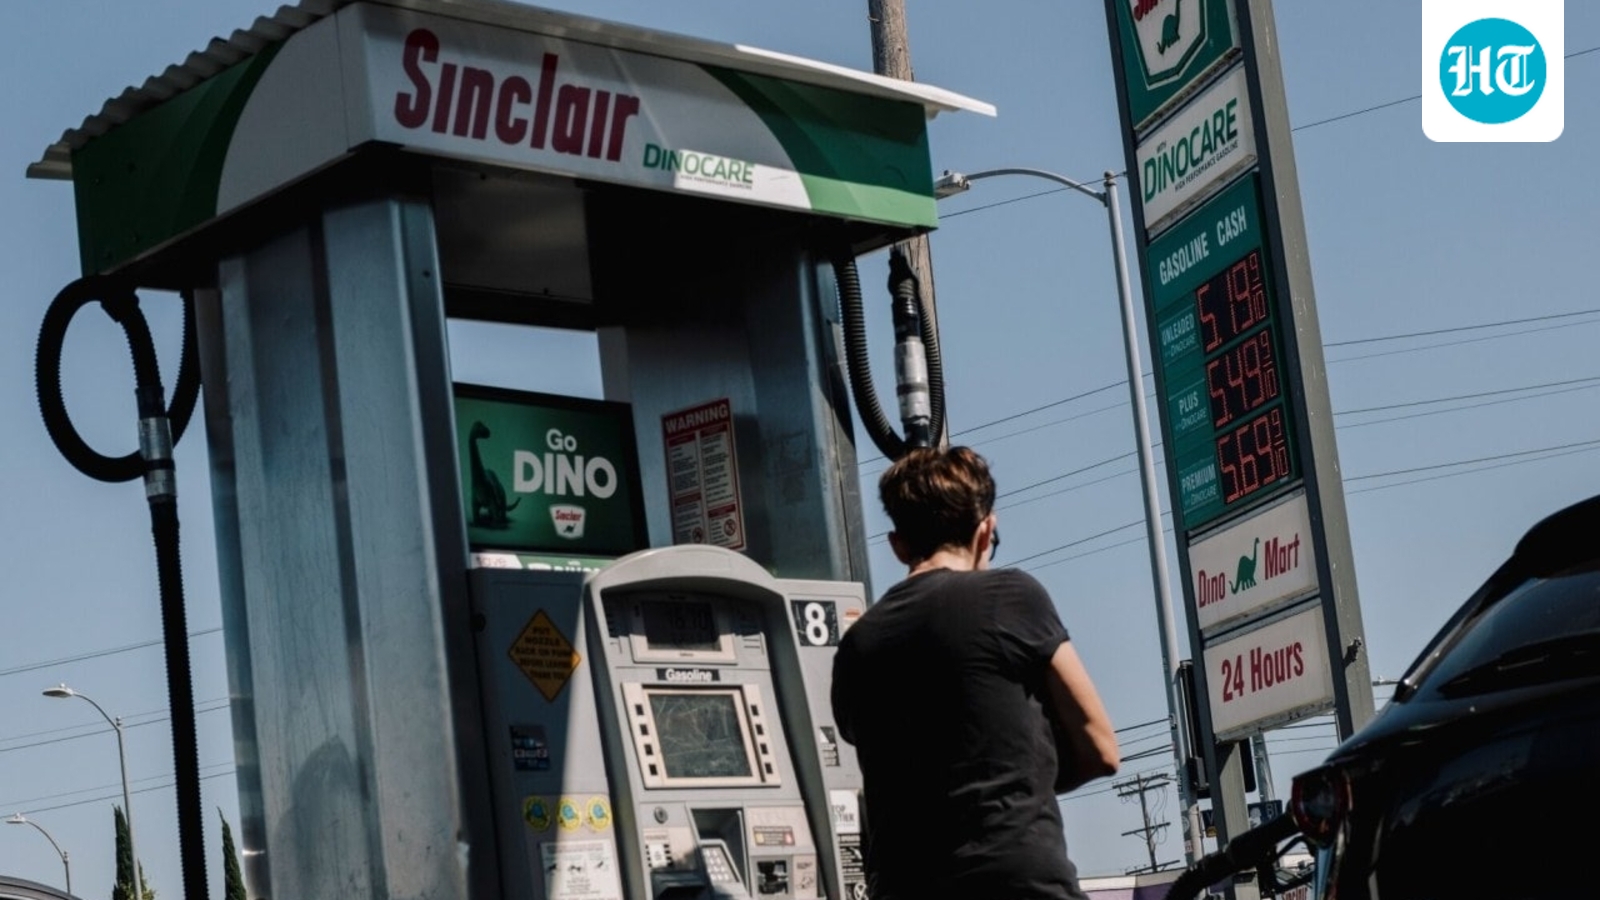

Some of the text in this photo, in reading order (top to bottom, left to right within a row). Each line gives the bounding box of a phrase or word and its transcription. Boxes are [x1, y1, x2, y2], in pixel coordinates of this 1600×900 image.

[395, 28, 640, 162] Sinclair
[643, 143, 755, 184] DINOCARE
[1144, 97, 1238, 205] DINOCARE
[1159, 205, 1247, 286] GASOLINE CASH
[1161, 312, 1195, 346] UNLEADED
[665, 404, 729, 434] WARNING
[1178, 390, 1199, 416] PLUS
[545, 428, 578, 452] Go
[513, 450, 618, 499] DINO
[1181, 463, 1217, 494] PREMIUM
[1198, 533, 1301, 608] Dino Mart
[804, 602, 830, 646] 8
[665, 668, 713, 682] Gasoline
[1221, 641, 1304, 703] 24 Hours
